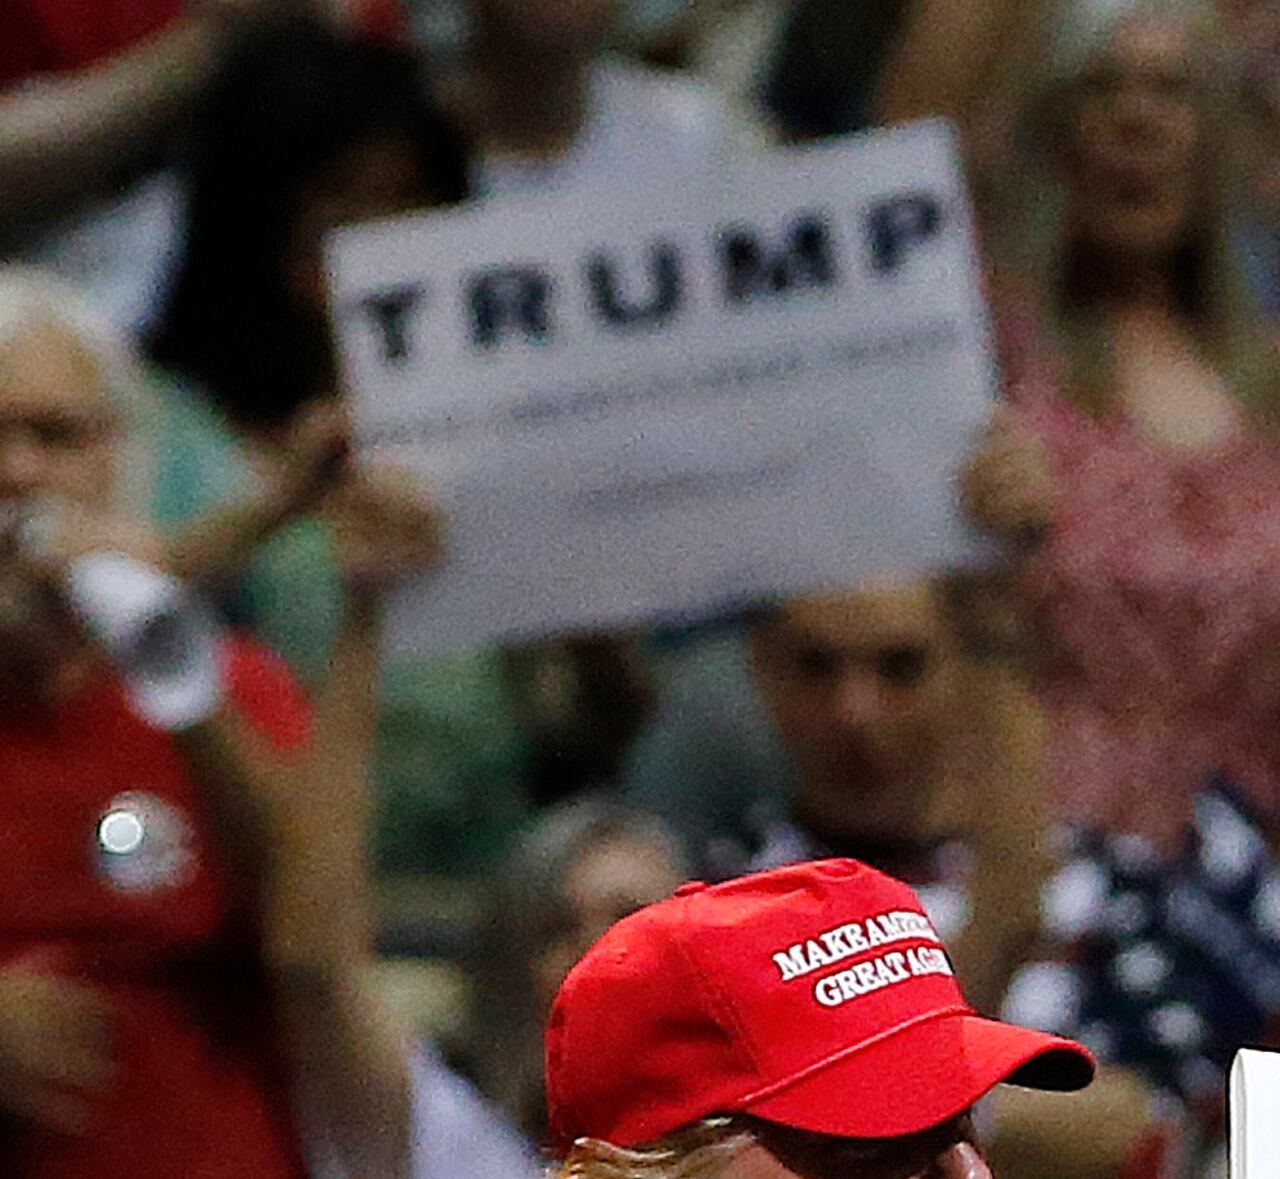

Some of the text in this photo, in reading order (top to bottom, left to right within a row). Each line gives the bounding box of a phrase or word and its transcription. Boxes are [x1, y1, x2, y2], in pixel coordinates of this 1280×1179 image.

[357, 188, 945, 366] TRUMP
[773, 923, 869, 980] MAKE
[816, 952, 910, 1005] GREAT
